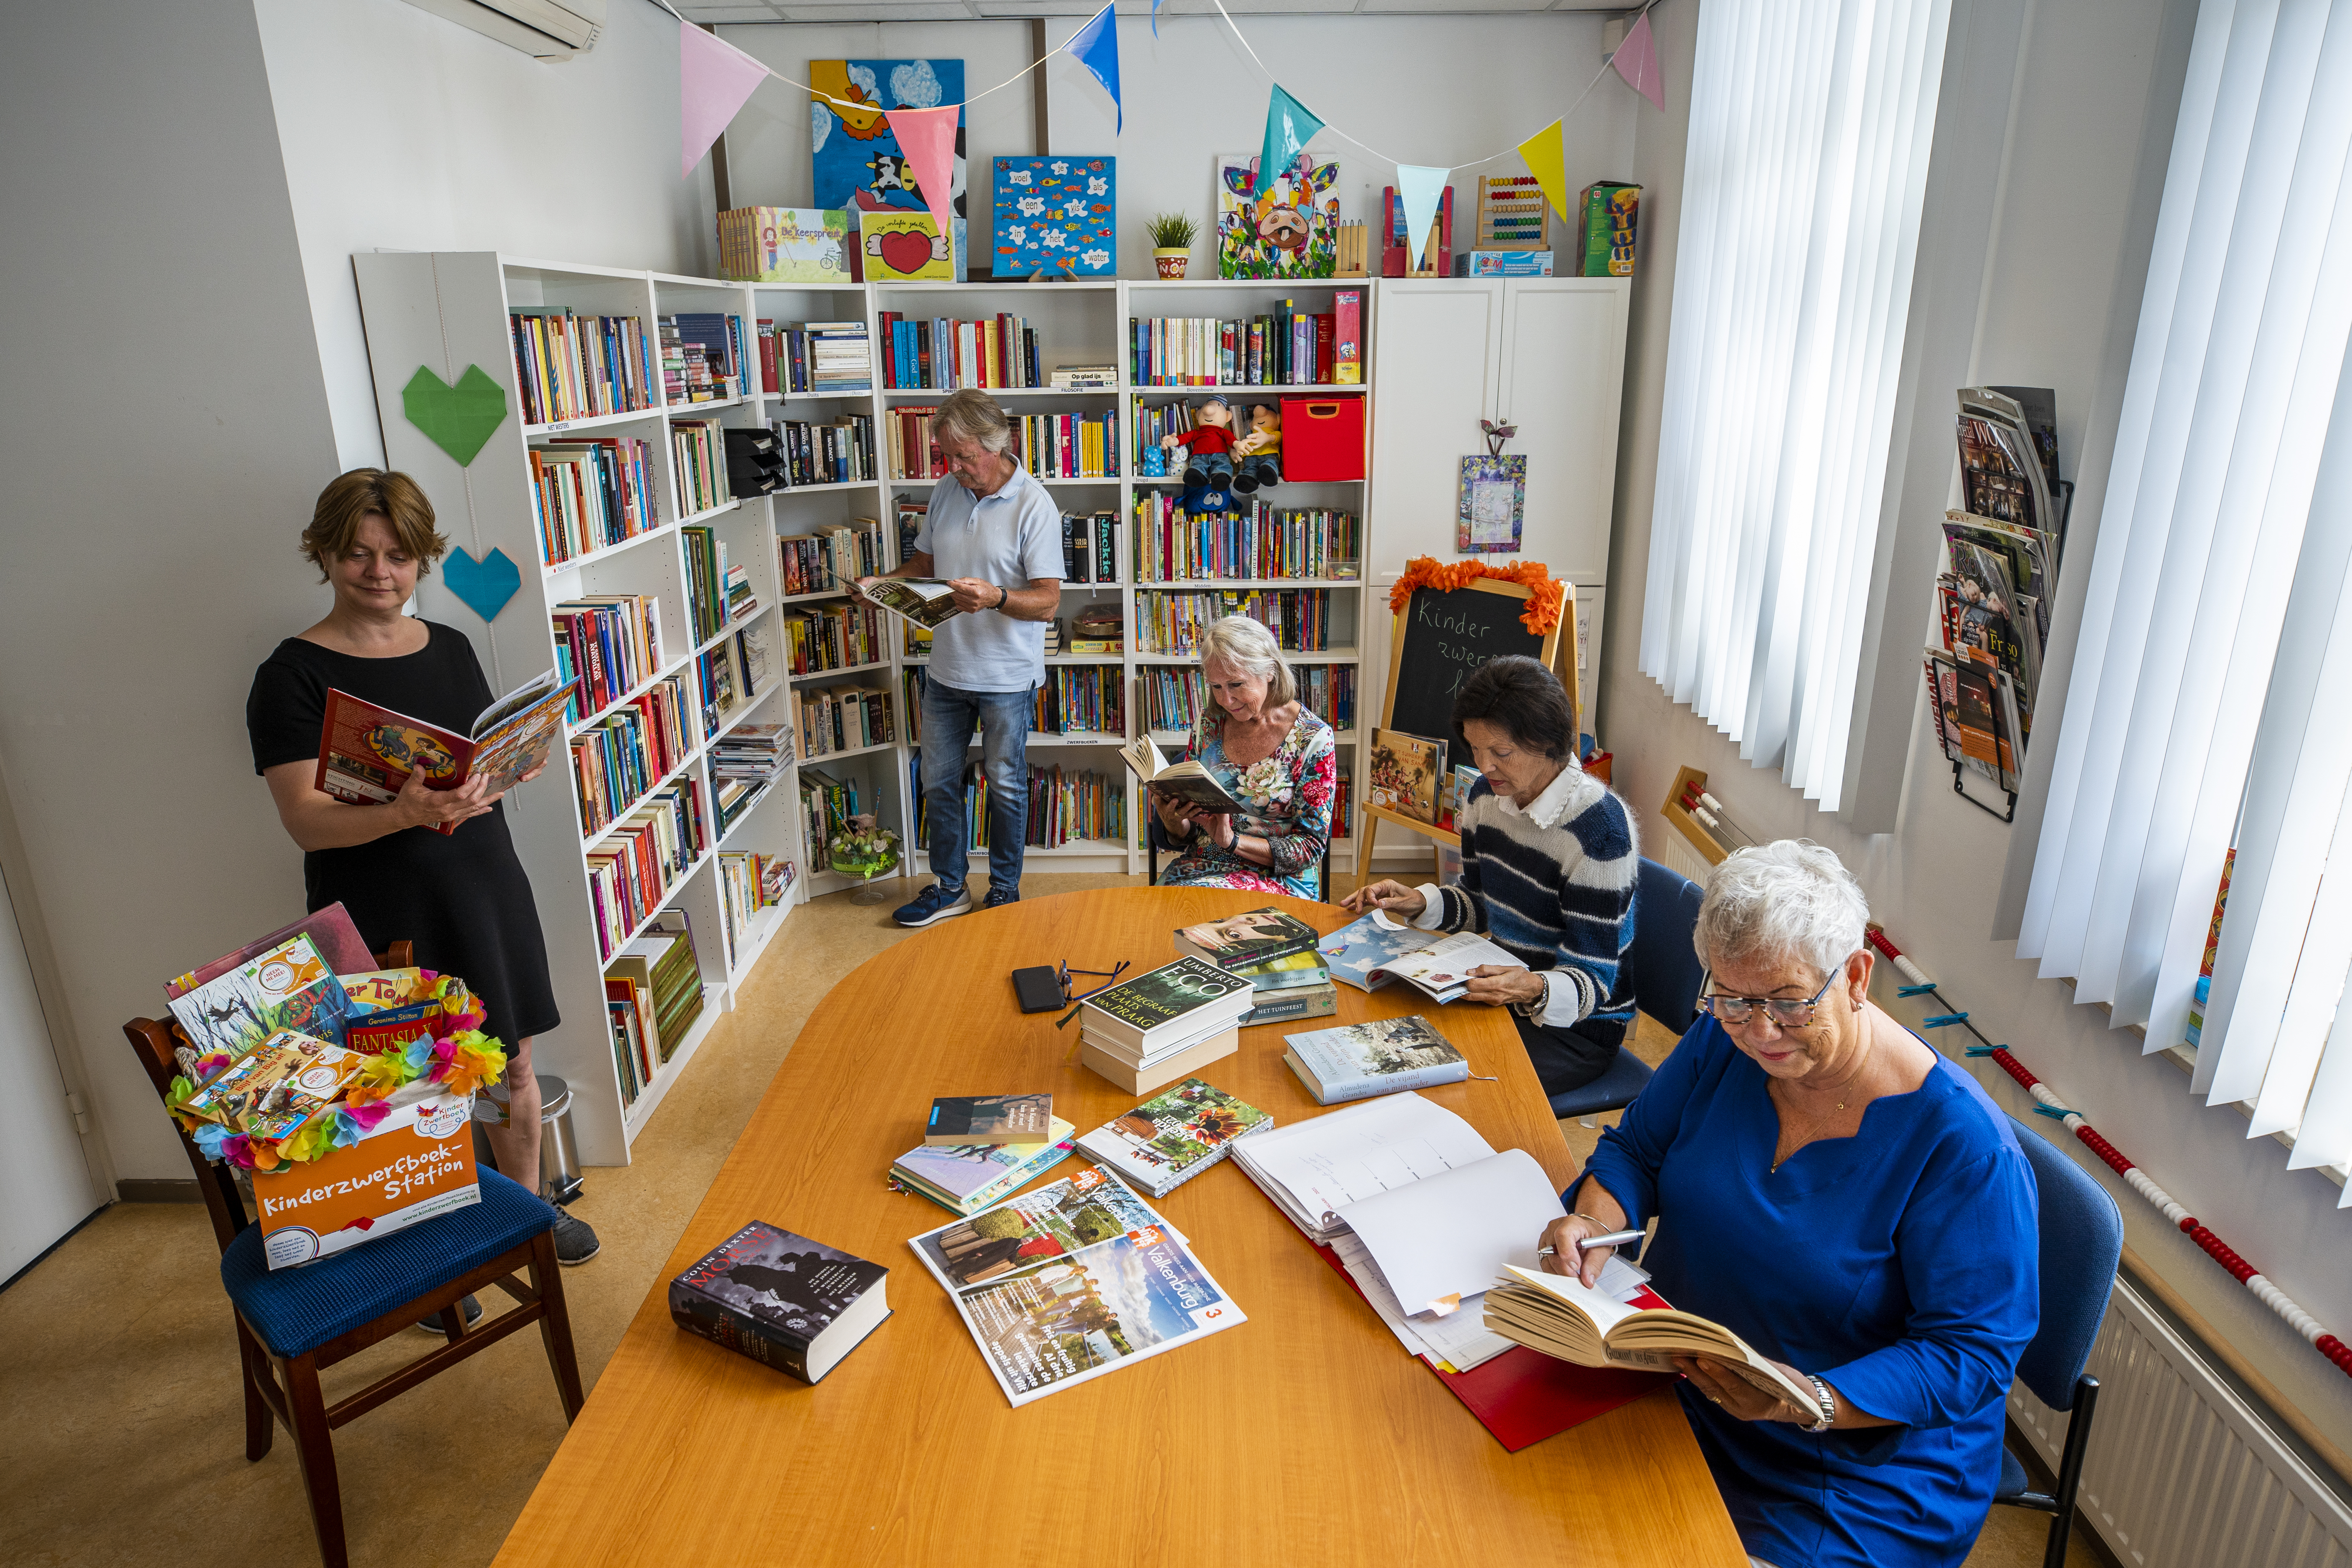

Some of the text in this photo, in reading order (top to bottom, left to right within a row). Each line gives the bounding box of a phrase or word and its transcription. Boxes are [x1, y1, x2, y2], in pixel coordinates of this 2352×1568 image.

[781, 227, 841, 241] De keerspreuk
[556, 422, 569, 431] WESTERS
[1101, 518, 1111, 575] Jackie
[565, 561, 576, 571] westers
[1419, 597, 1490, 638] Kinder
[1438, 642, 1505, 667] zwer
[1956, 648, 1968, 656] LEVEN
[1990, 633, 2017, 657] Frso
[589, 643, 599, 681] AYATOLLAH
[480, 726, 508, 750] SAM
[530, 685, 573, 715] SARAH
[508, 723, 525, 735] MEER
[584, 718, 596, 729] westers
[327, 773, 355, 785] STICHTING
[1231, 957, 1260, 968] eenzaamheid
[1274, 945, 1302, 958] priemgetallen
[1238, 953, 1257, 961] Giordano
[266, 967, 281, 977] NEEM
[274, 969, 286, 979] MEE!
[1159, 965, 1228, 997] ECO
[1184, 959, 1243, 987] UMBERTO
[333, 1007, 345, 1016] HOUT
[1106, 991, 1143, 1010] PLAATS
[1116, 987, 1177, 1016] DE BEGRAAF-
[1271, 1003, 1303, 1013] TUINFEEST
[368, 1012, 418, 1025] Geronimo Stilton
[1094, 997, 1155, 1028] VAN PRAAG
[352, 1028, 418, 1052] FANTASIA
[1303, 1035, 1320, 1055] Grandes
[1317, 1051, 1340, 1076] Almudena
[1320, 1042, 1346, 1066] De vijand
[1327, 1034, 1361, 1070] van mijn vader
[235, 1053, 286, 1092] Blijf van Big af!
[1385, 1072, 1420, 1085] De vijand
[1339, 1083, 1370, 1093] Almudena
[1342, 1089, 1367, 1099] Grandes
[423, 1108, 464, 1127] Zwerfboek
[439, 1102, 464, 1115] Kinder
[1028, 1112, 1036, 1132] Kaapstad
[264, 1143, 462, 1217] Kinderzwerfboek-
[383, 1160, 464, 1201] Station
[402, 1193, 477, 1222] www.kinderzwerfboek.nl
[683, 1225, 758, 1282] COLIN DEXTER
[689, 1229, 771, 1289] MORSE
[809, 1265, 837, 1288] VAN JERICHO
[814, 1266, 830, 1279] DODEN
[820, 1265, 848, 1288] WOLVERCOTE
[825, 1273, 845, 1290] JUWELEN
[1147, 1245, 1199, 1309] Valkenburg
[1162, 1243, 1212, 1302] GRATIS HUIS-AAN-HUIS MAGAZINE
[828, 1272, 857, 1297] HET WYTHAM
[837, 1277, 858, 1295] MYSTERIE
[1206, 1308, 1223, 1319] 3
[1015, 1332, 1051, 1383] generaties de
[1042, 1324, 1076, 1374] Fris en fruitig
[992, 1340, 1027, 1392] appels uit Vilt
[1014, 1351, 1039, 1388] lekkerste
[1043, 1352, 1063, 1378] Al drie
